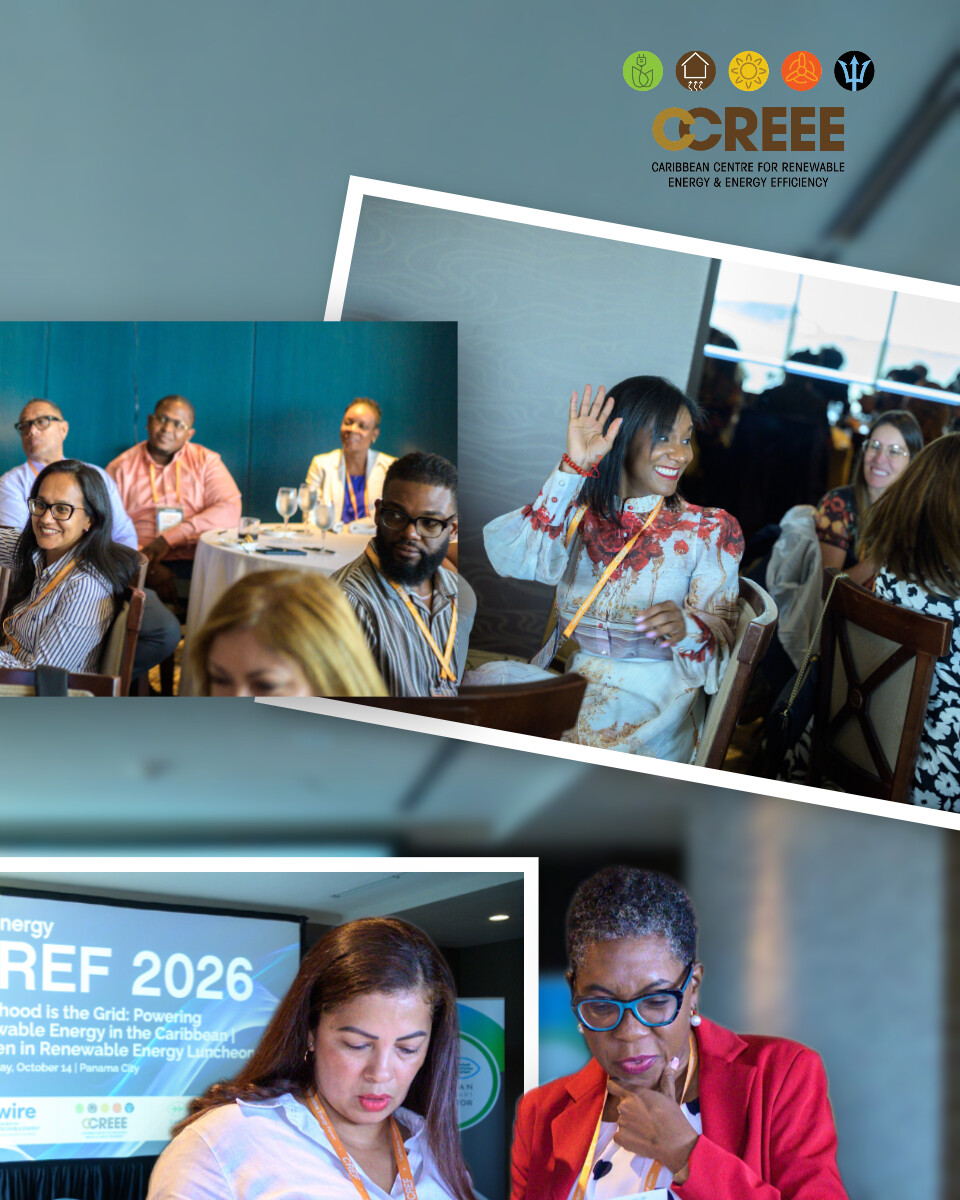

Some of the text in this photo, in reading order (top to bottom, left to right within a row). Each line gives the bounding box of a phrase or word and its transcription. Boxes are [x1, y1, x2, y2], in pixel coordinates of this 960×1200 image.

[131, 950, 254, 1002] 2026
[45, 1003, 59, 1020] is
[62, 1004, 90, 1020] the
[92, 1006, 131, 1022] Grid:
[133, 1007, 202, 1028] Powering
[49, 1022, 106, 1043] Energy
[109, 1024, 124, 1040] in
[126, 1025, 152, 1040] the
[154, 1026, 229, 1042] Caribbean
[20, 1040, 36, 1056] in
[39, 1040, 129, 1057] Renewable
[132, 1043, 184, 1062] Energy
[16, 1062, 59, 1073] October
[61, 1063, 72, 1075] 14
[79, 1063, 119, 1074] Panama
[120, 1063, 140, 1076] City
[402, 1178, 417, 1200] CREF
